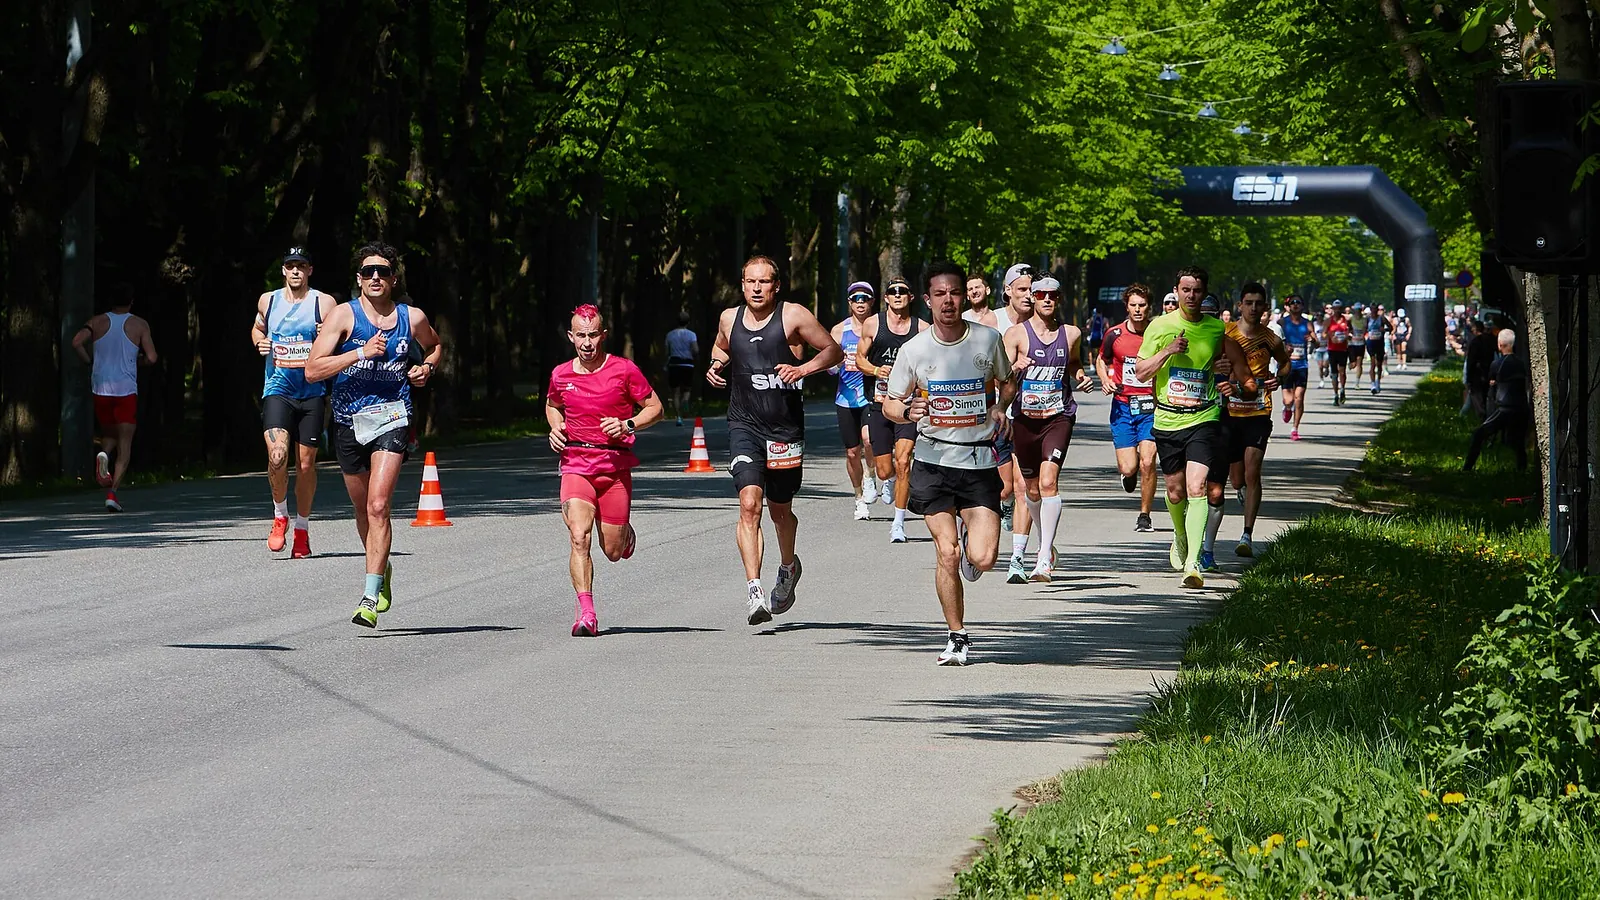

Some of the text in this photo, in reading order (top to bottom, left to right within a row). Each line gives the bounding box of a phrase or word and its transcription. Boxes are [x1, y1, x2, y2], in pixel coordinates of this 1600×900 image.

[289, 347, 311, 355] Marko
[930, 383, 975, 392] SPARKASSE
[954, 399, 983, 409] Simon
